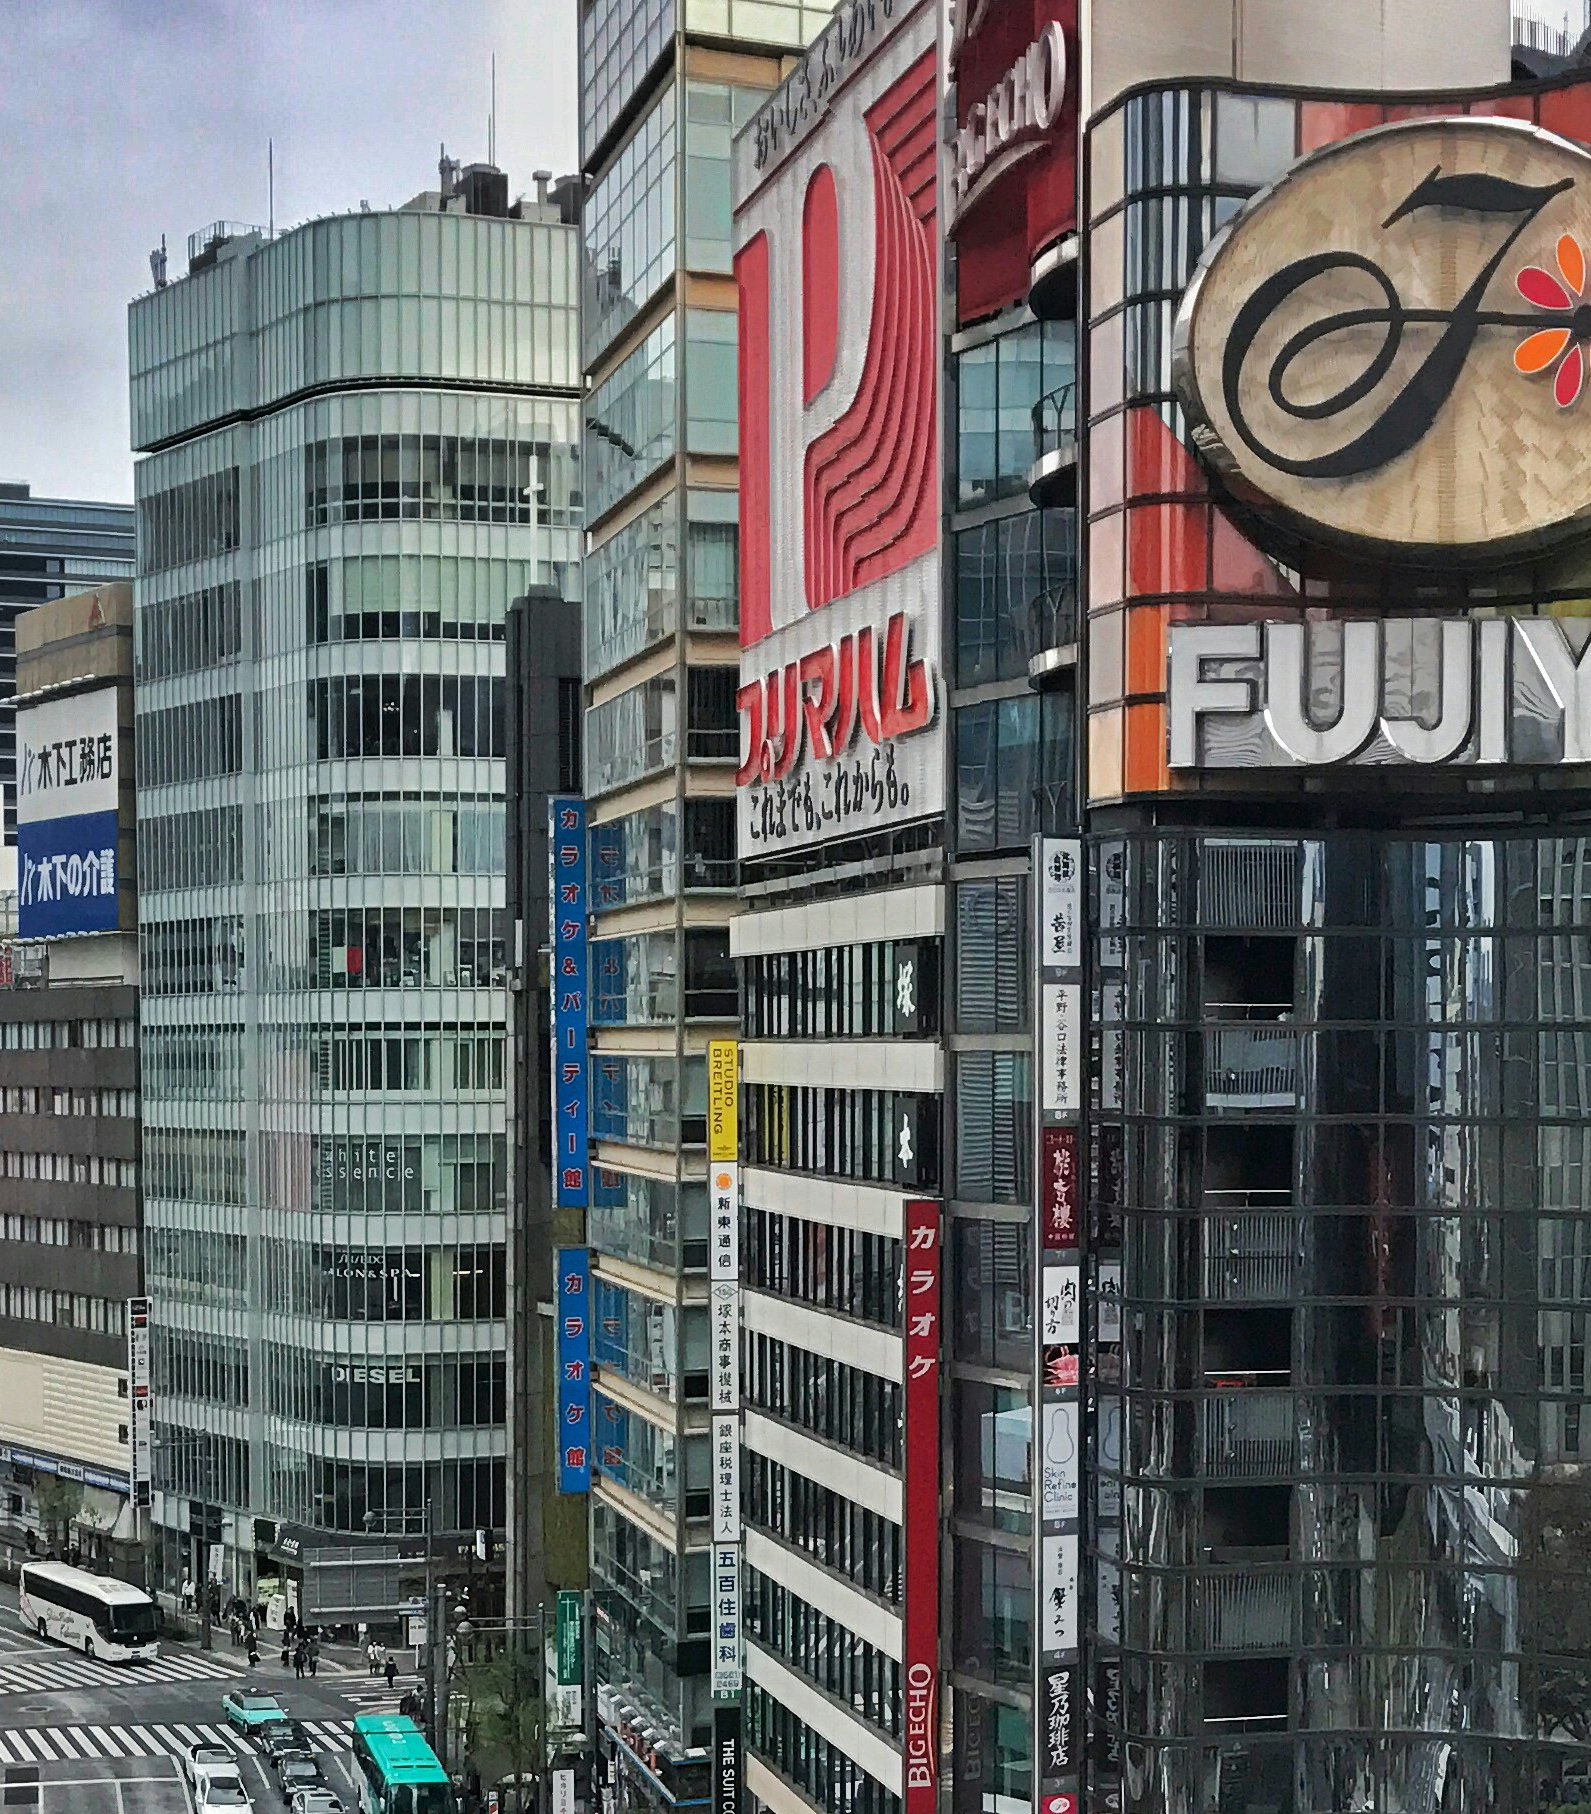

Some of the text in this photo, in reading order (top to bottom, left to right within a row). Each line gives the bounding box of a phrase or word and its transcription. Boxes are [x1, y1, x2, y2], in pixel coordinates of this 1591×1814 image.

[37, 733, 113, 790] 木下工務店
[750, 743, 910, 842] これまでも、これからも。
[37, 848, 115, 902] 木下の介護
[561, 808, 583, 1190] カラオケ&パーティー館
[713, 1048, 723, 1135] BREITLING
[724, 1048, 734, 1108] STUDIO
[717, 1197, 732, 1268] 新東通信
[909, 1225, 936, 1380] カラオケ
[564, 1273, 585, 1467] カラオケ館
[717, 1303, 733, 1404] 塚本商事機械
[718, 1423, 733, 1534] 銀座税理士法人
[1044, 1467, 1066, 1480] Skin
[1044, 1479, 1077, 1491] Refine
[1044, 1491, 1074, 1503] Clinic
[718, 1551, 736, 1663] 五百住歯科
[723, 1738, 735, 1766] THE
[908, 1662, 932, 1788] BIGECHO
[1047, 1670, 1071, 1769] 星乃珈琲店
[723, 1767, 735, 1791] SUIT
